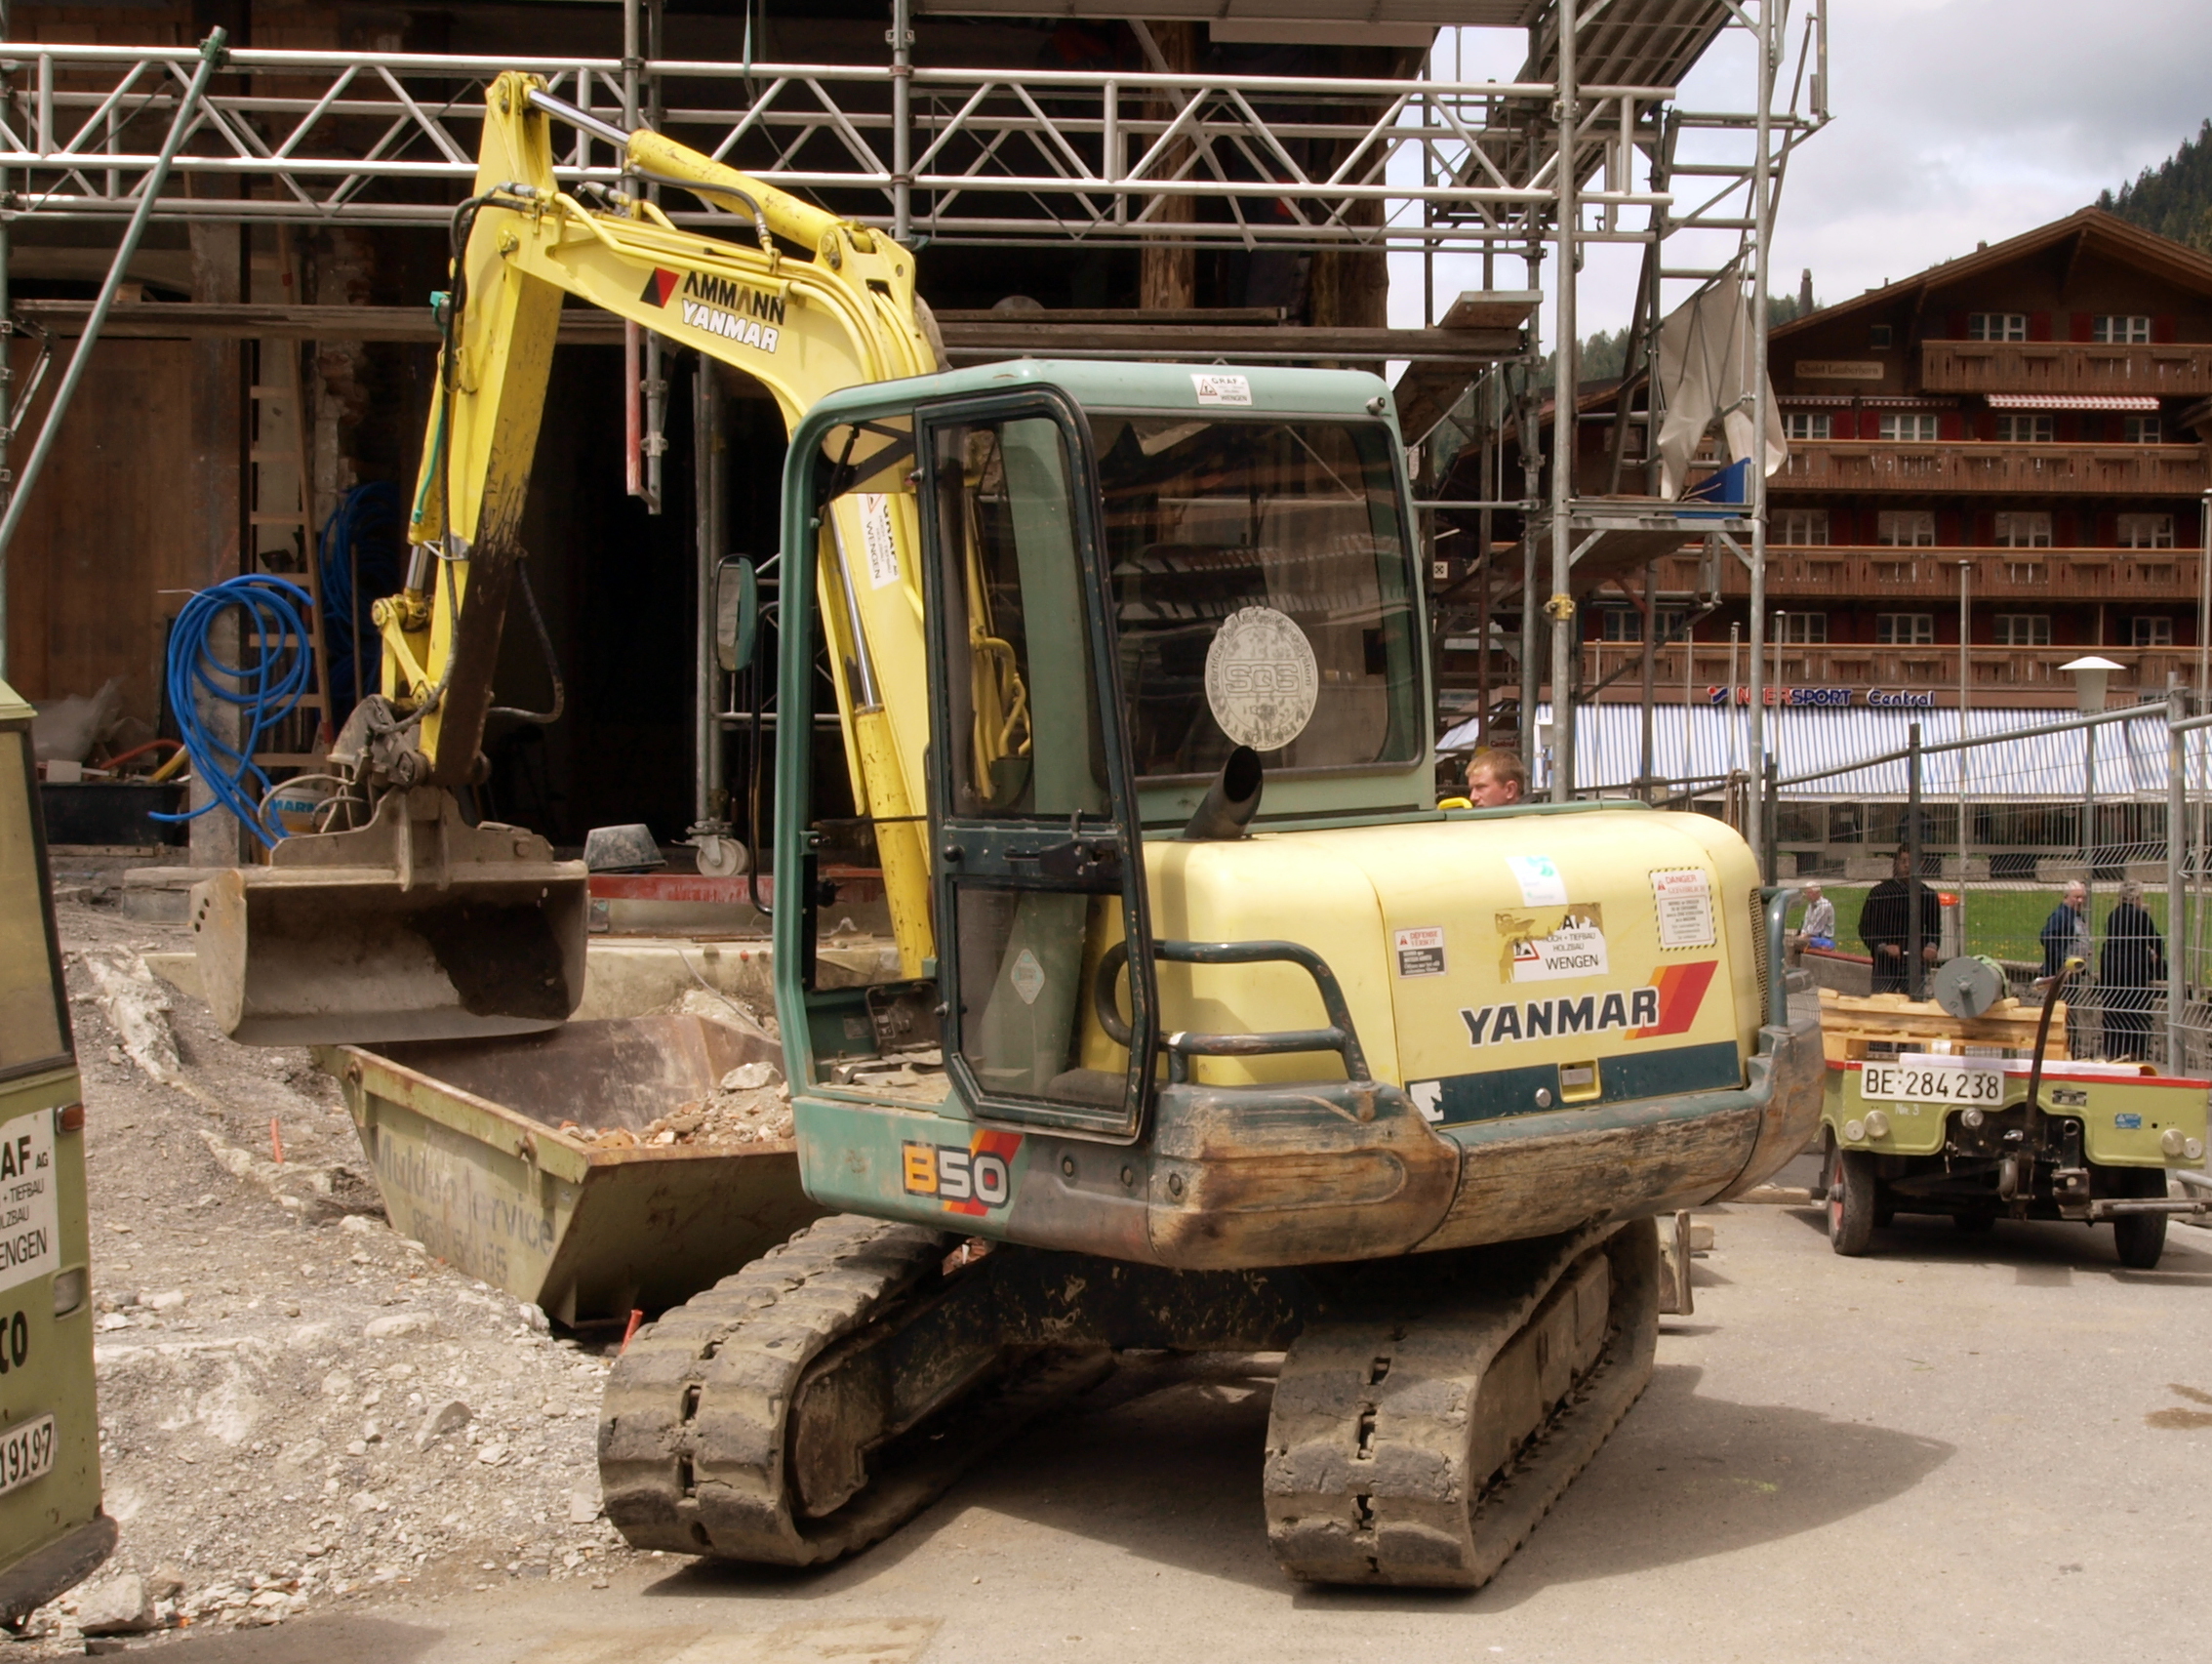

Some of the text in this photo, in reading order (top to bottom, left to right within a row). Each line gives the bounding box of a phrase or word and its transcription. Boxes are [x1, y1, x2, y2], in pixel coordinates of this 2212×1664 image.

[684, 270, 785, 325] AMMANN
[683, 299, 779, 353] YANMAR
[1225, 664, 1300, 693] SQS
[1868, 687, 1935, 707] Central
[1666, 874, 1697, 884] DANGER
[1553, 943, 1585, 952] HOLZBAU
[1546, 954, 1599, 970] WENGEN
[1461, 987, 1660, 1046] YANMAR
[1912, 1104, 1920, 1116] 3
[35, 1152, 49, 1169] AG
[902, 1140, 1011, 1209] B50
[10, 1178, 45, 1203] TIEFBAU
